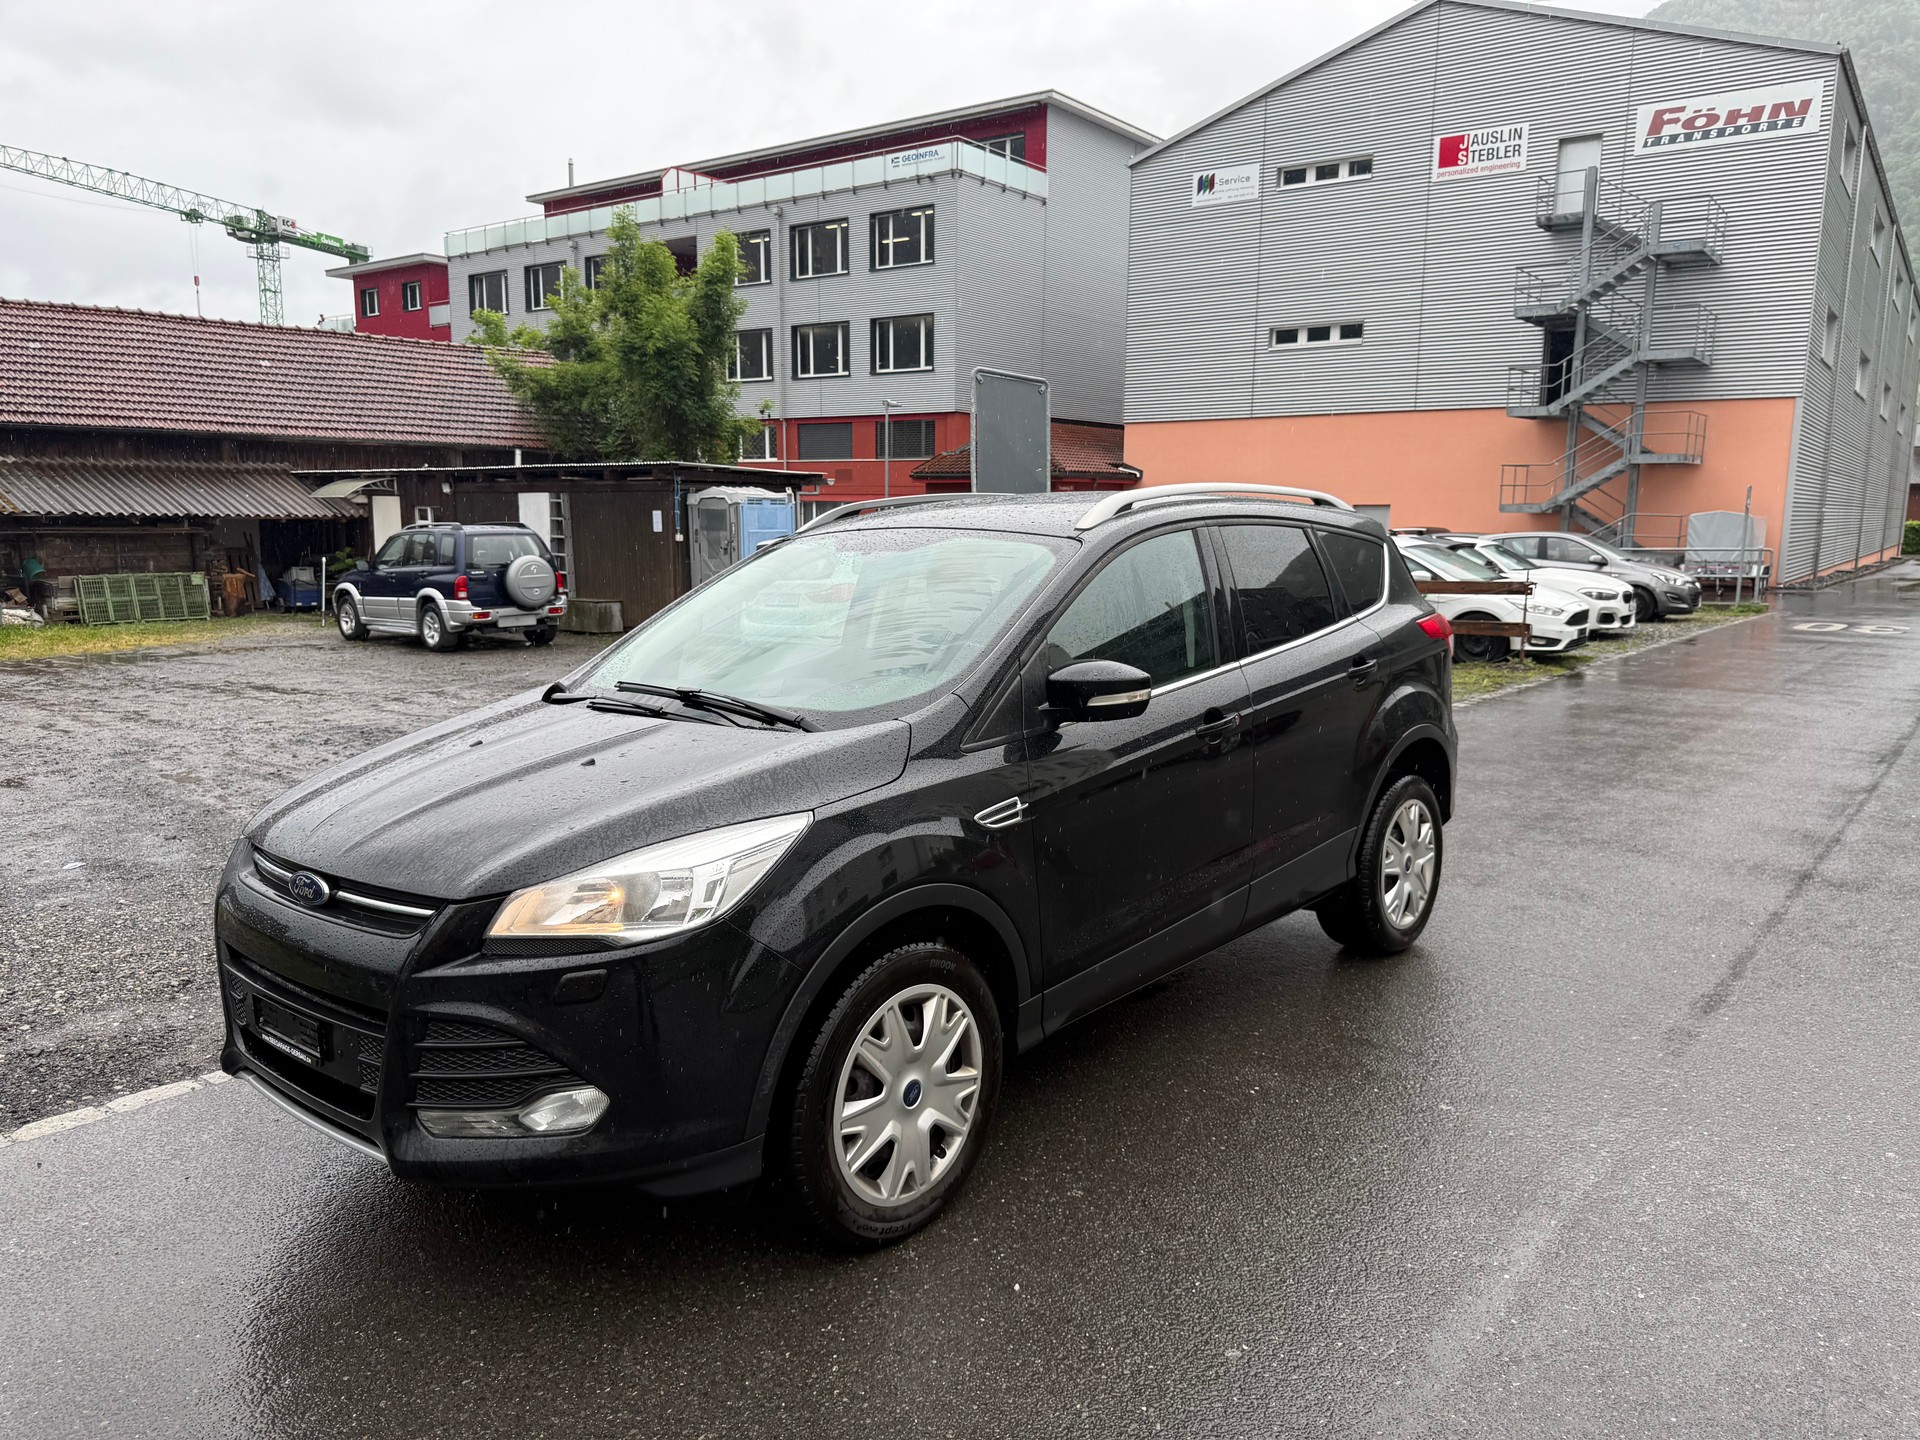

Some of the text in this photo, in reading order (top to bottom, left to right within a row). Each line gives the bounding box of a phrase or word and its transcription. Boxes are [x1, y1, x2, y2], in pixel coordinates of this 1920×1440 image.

[1646, 98, 1814, 137] FÖHN
[1459, 127, 1523, 149] JAUSLIN
[1645, 116, 1805, 148] TRANSPORTE
[901, 149, 939, 163] GEOINFRA
[1457, 144, 1522, 166] STEBLER
[1436, 161, 1521, 180] personalized engineering
[293, 875, 316, 899] Ford
